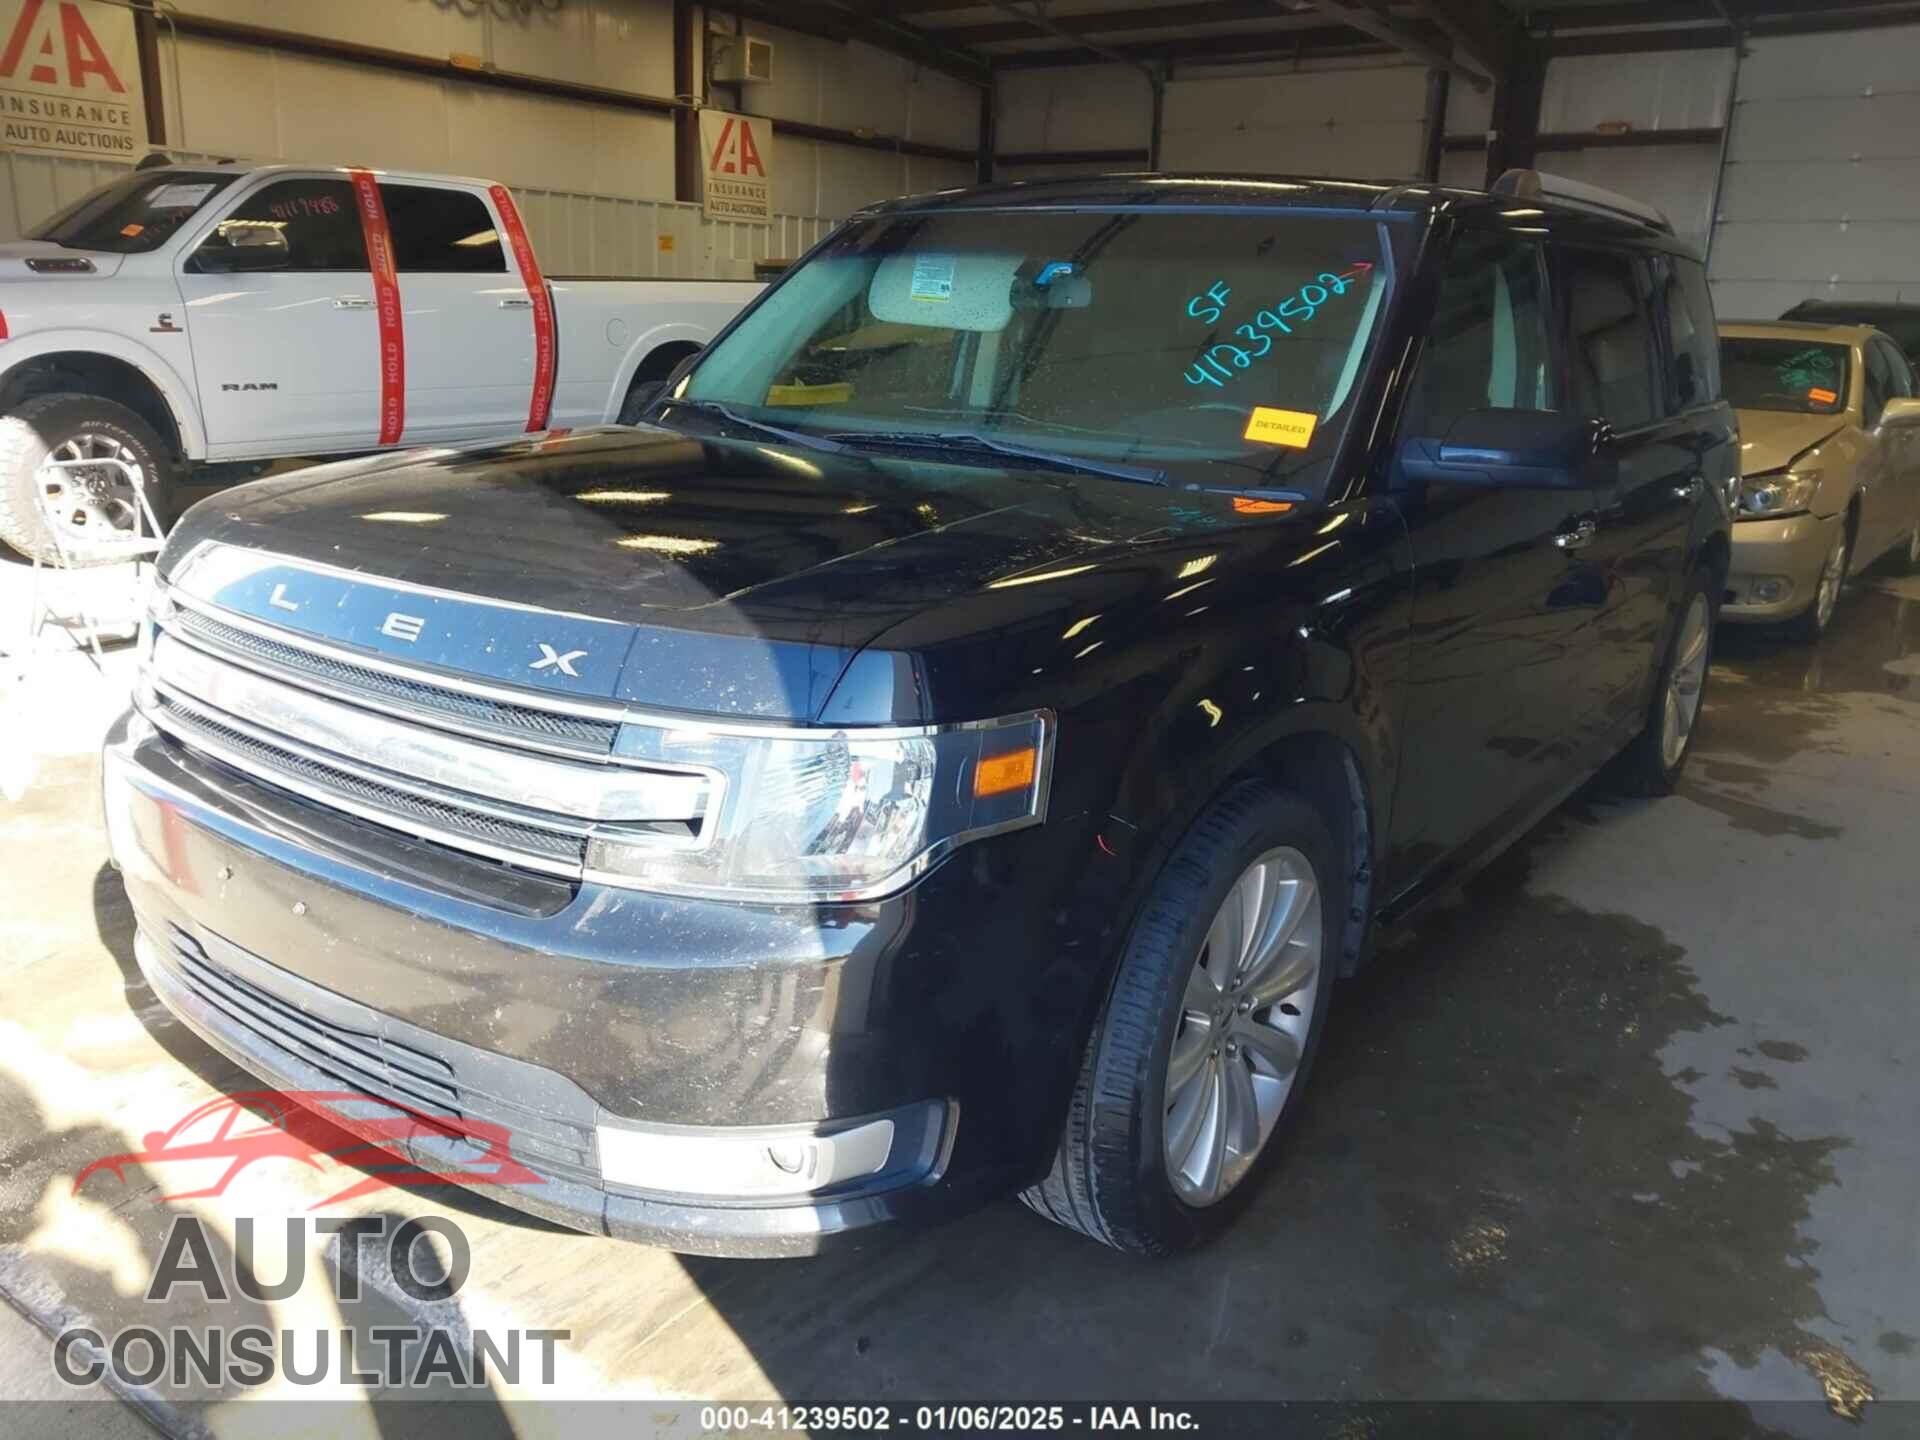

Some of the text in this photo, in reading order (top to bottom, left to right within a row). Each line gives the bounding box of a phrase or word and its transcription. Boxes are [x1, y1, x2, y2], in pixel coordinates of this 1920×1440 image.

[0, 94, 130, 125] INSURANCE
[5, 123, 134, 150] AUTO AUCTIONS
[708, 182, 767, 199] INSURANCE
[710, 199, 767, 216] AUTO AUCTIONS
[381, 286, 396, 328] HOLD
[1188, 280, 1231, 324] SF
[1183, 272, 1356, 386] 41239502
[386, 342, 400, 384] HOLD
[221, 383, 279, 391] RAM
[387, 397, 399, 436] HOLD
[1255, 420, 1306, 433] DETAILED
